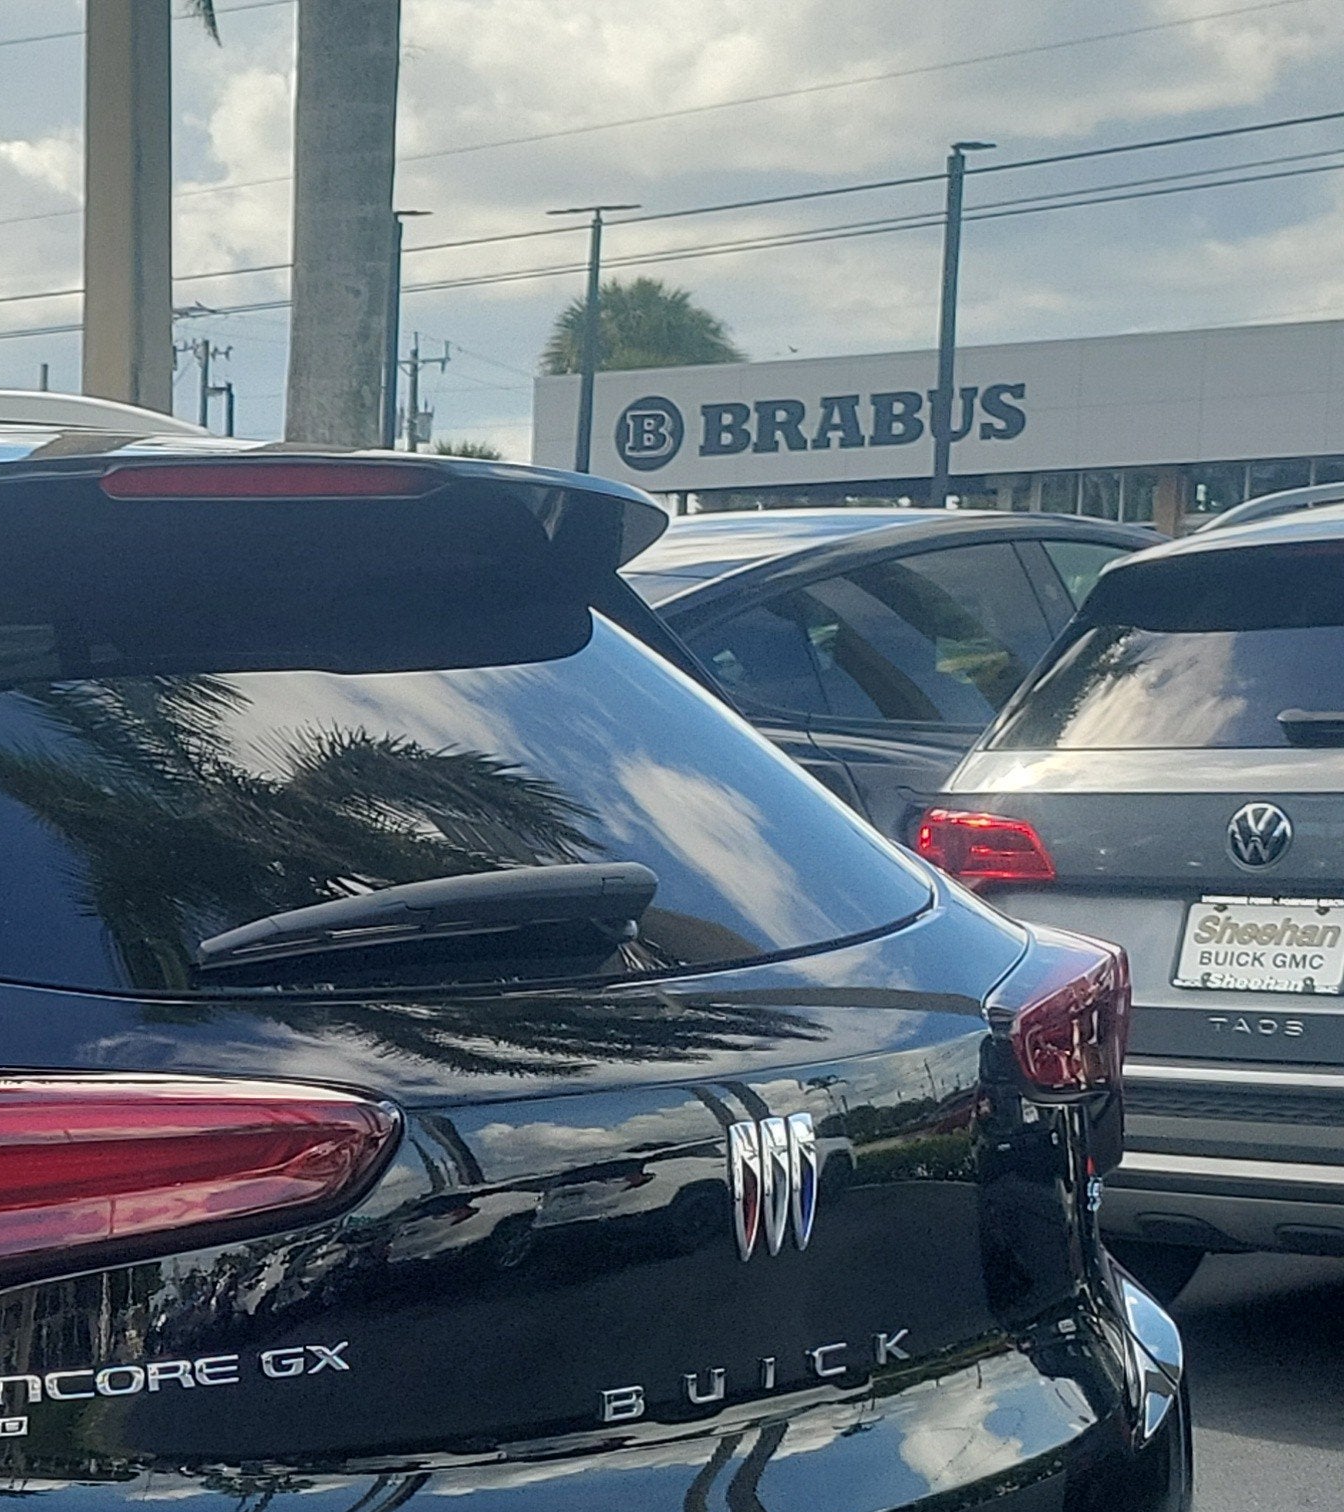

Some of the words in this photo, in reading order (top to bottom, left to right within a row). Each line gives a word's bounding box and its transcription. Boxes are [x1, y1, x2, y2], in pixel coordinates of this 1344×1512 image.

[699, 383, 1025, 457] BRABUS
[1194, 915, 1341, 947] Sheehan
[1199, 951, 1266, 967] BUICK
[1273, 953, 1324, 969] GMC
[1209, 1018, 1304, 1036] TAOS
[261, 1341, 350, 1378] GX
[601, 1329, 910, 1422] BUICK
